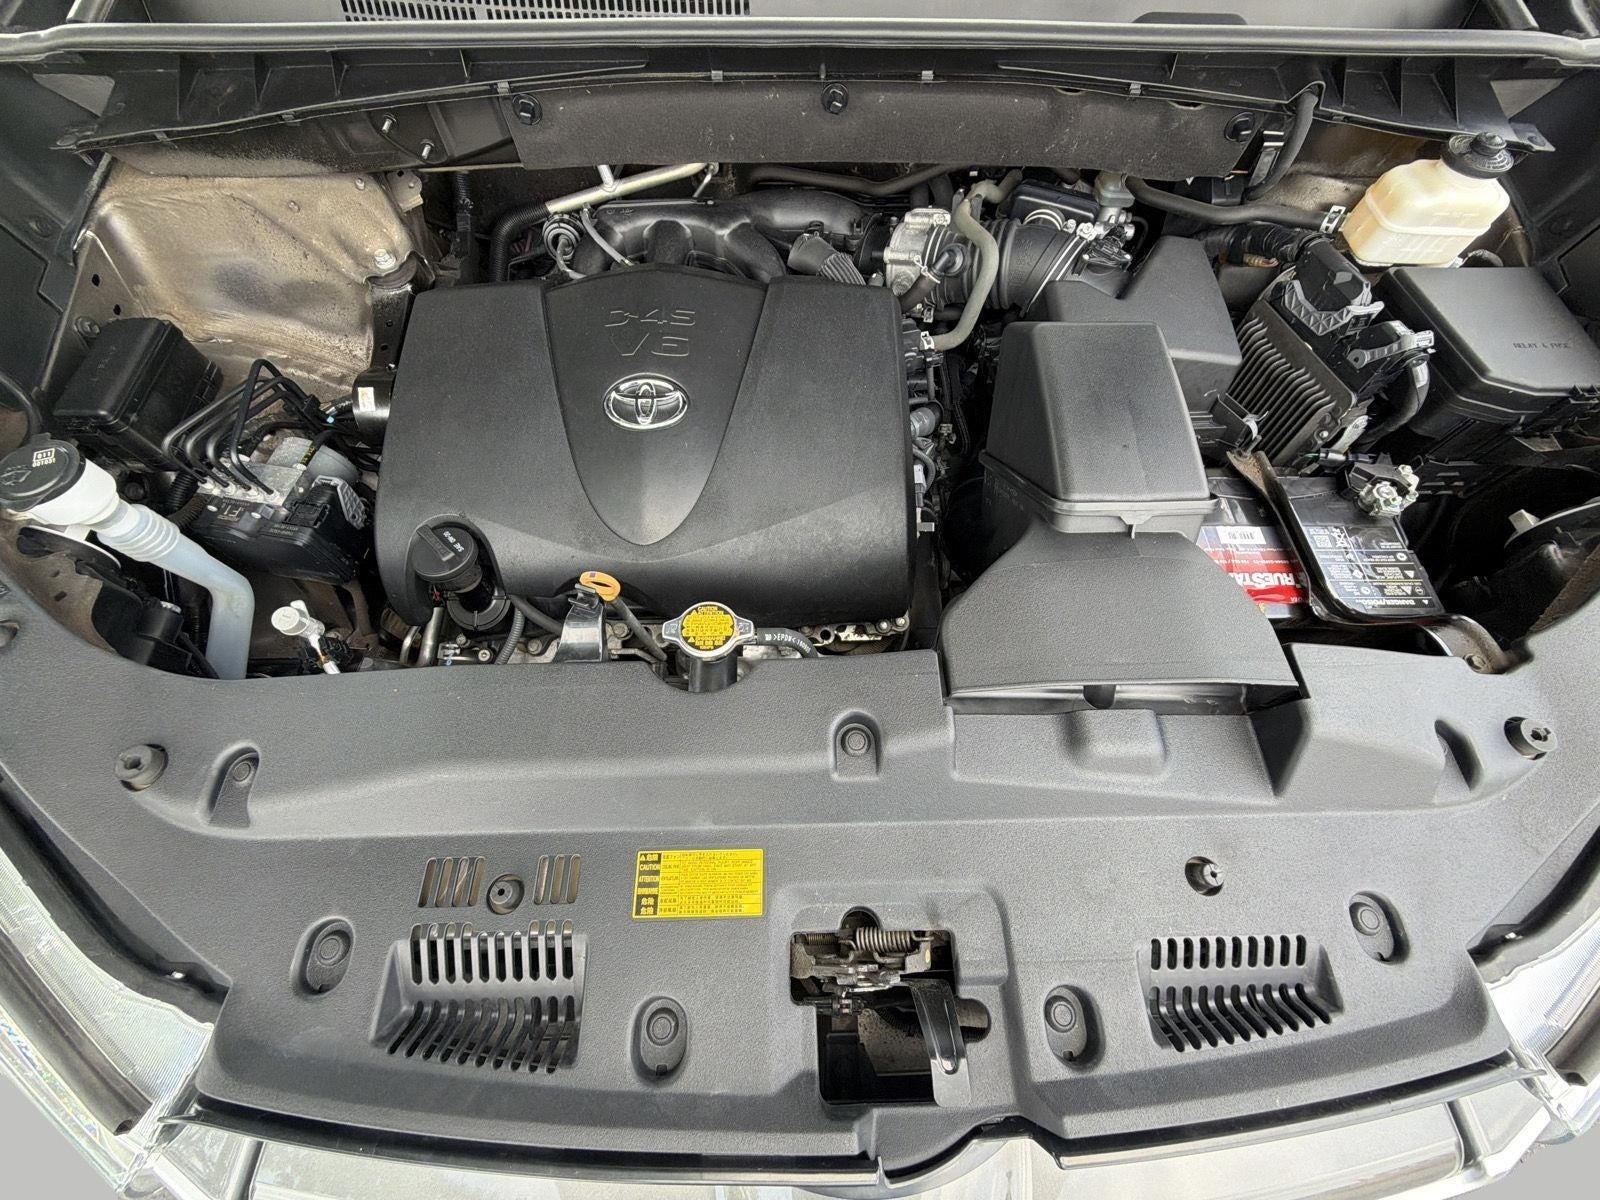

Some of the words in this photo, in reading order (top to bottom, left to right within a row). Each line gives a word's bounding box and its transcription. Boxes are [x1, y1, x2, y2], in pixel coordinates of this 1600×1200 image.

[611, 332, 690, 357] V6
[453, 542, 465, 553] SAE
[1229, 572, 1302, 589] RUESTA
